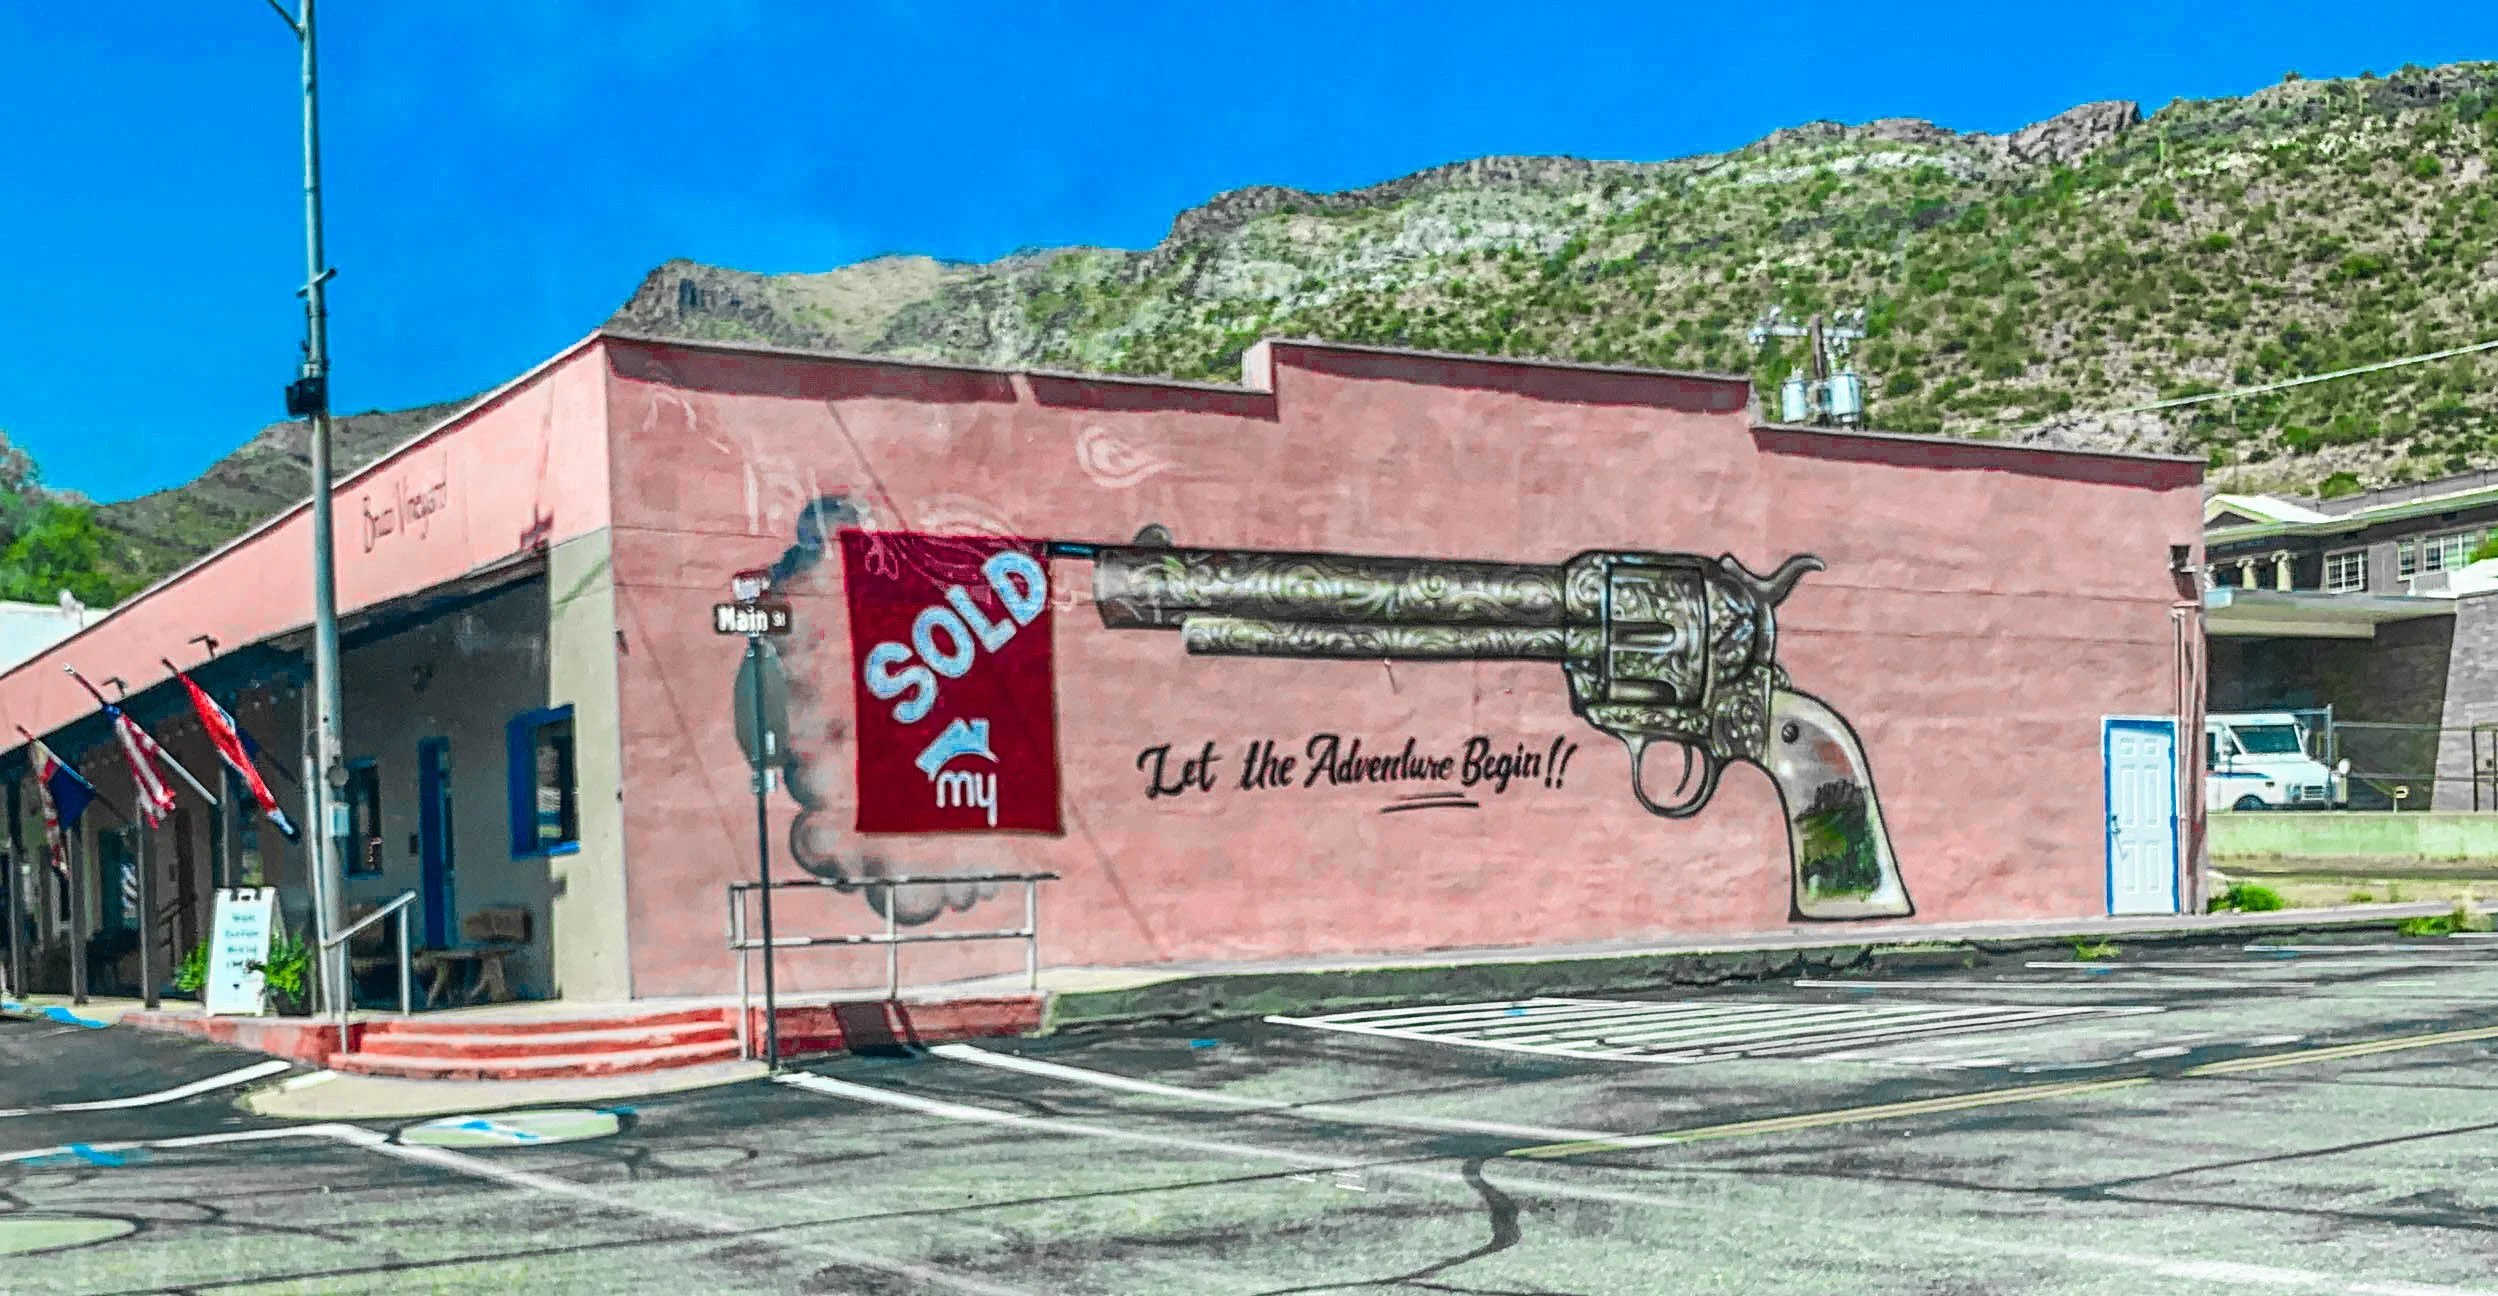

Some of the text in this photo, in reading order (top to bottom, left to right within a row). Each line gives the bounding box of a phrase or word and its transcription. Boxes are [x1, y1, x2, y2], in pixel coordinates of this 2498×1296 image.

[717, 605, 769, 632] Main
[864, 550, 1048, 725] SOLD
[1136, 733, 1579, 799] Let the Adventure Begin!!
[936, 770, 998, 828] my
